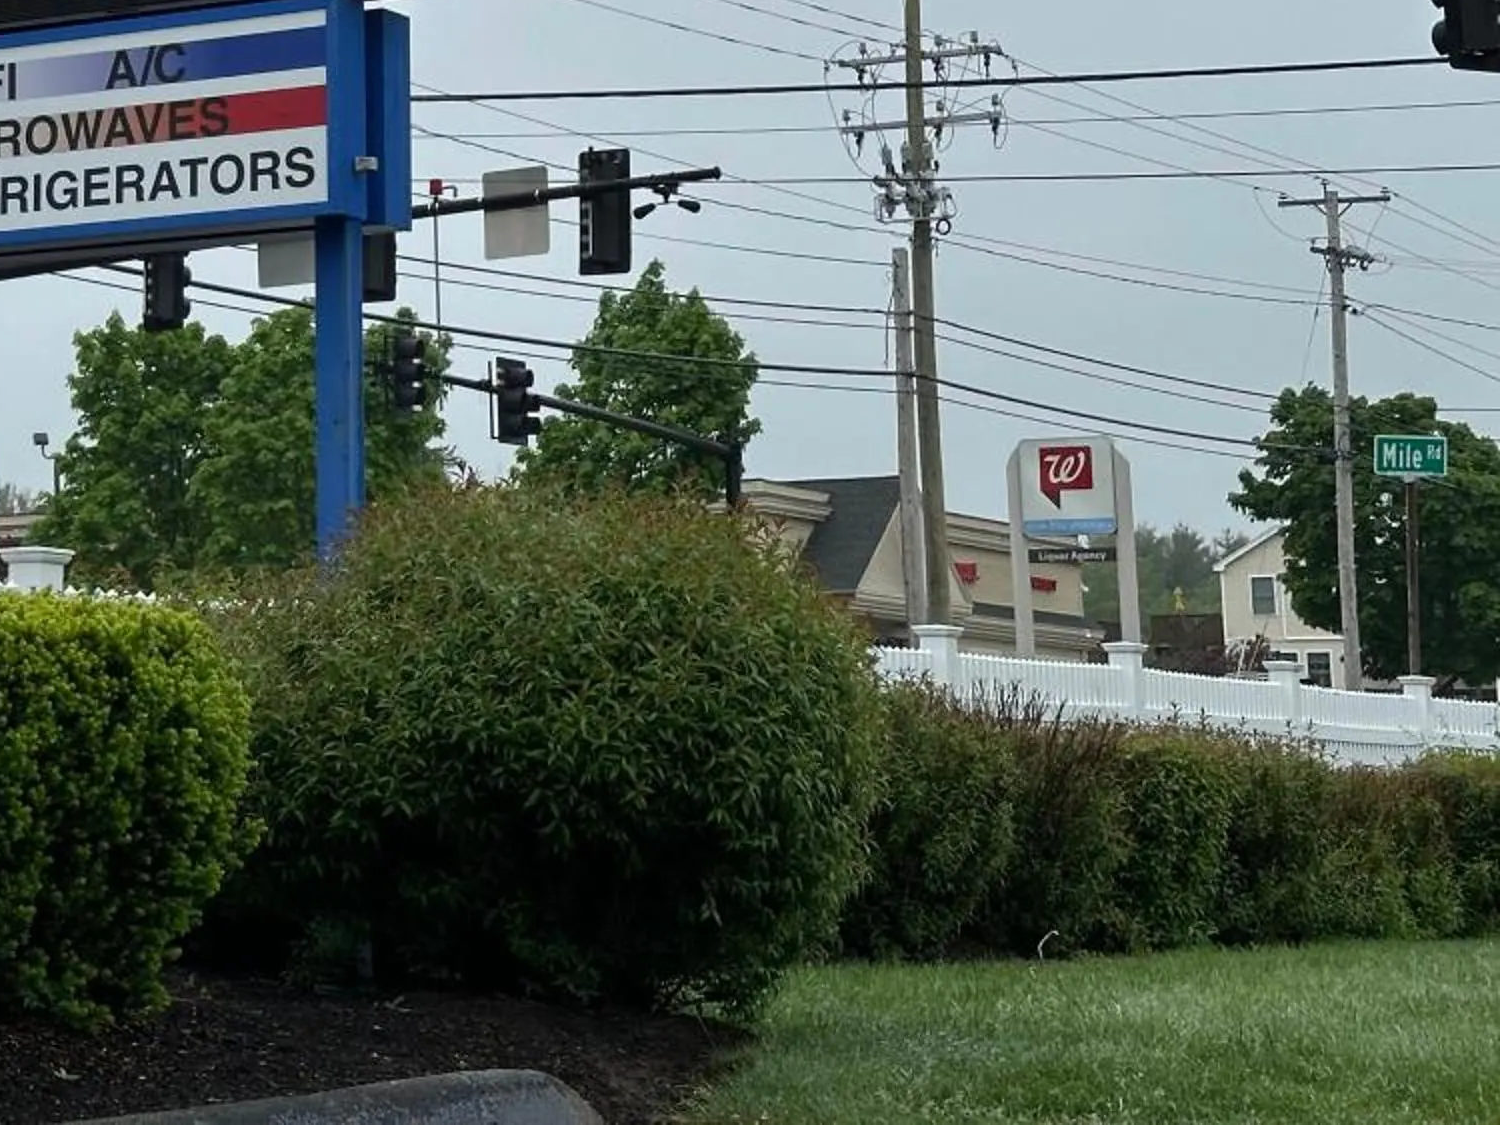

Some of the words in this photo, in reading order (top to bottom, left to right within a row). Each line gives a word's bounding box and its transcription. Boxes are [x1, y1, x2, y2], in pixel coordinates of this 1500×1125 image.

[105, 43, 188, 93] A/C
[1382, 442, 1423, 469] Mile
[1427, 444, 1442, 460] Rd
